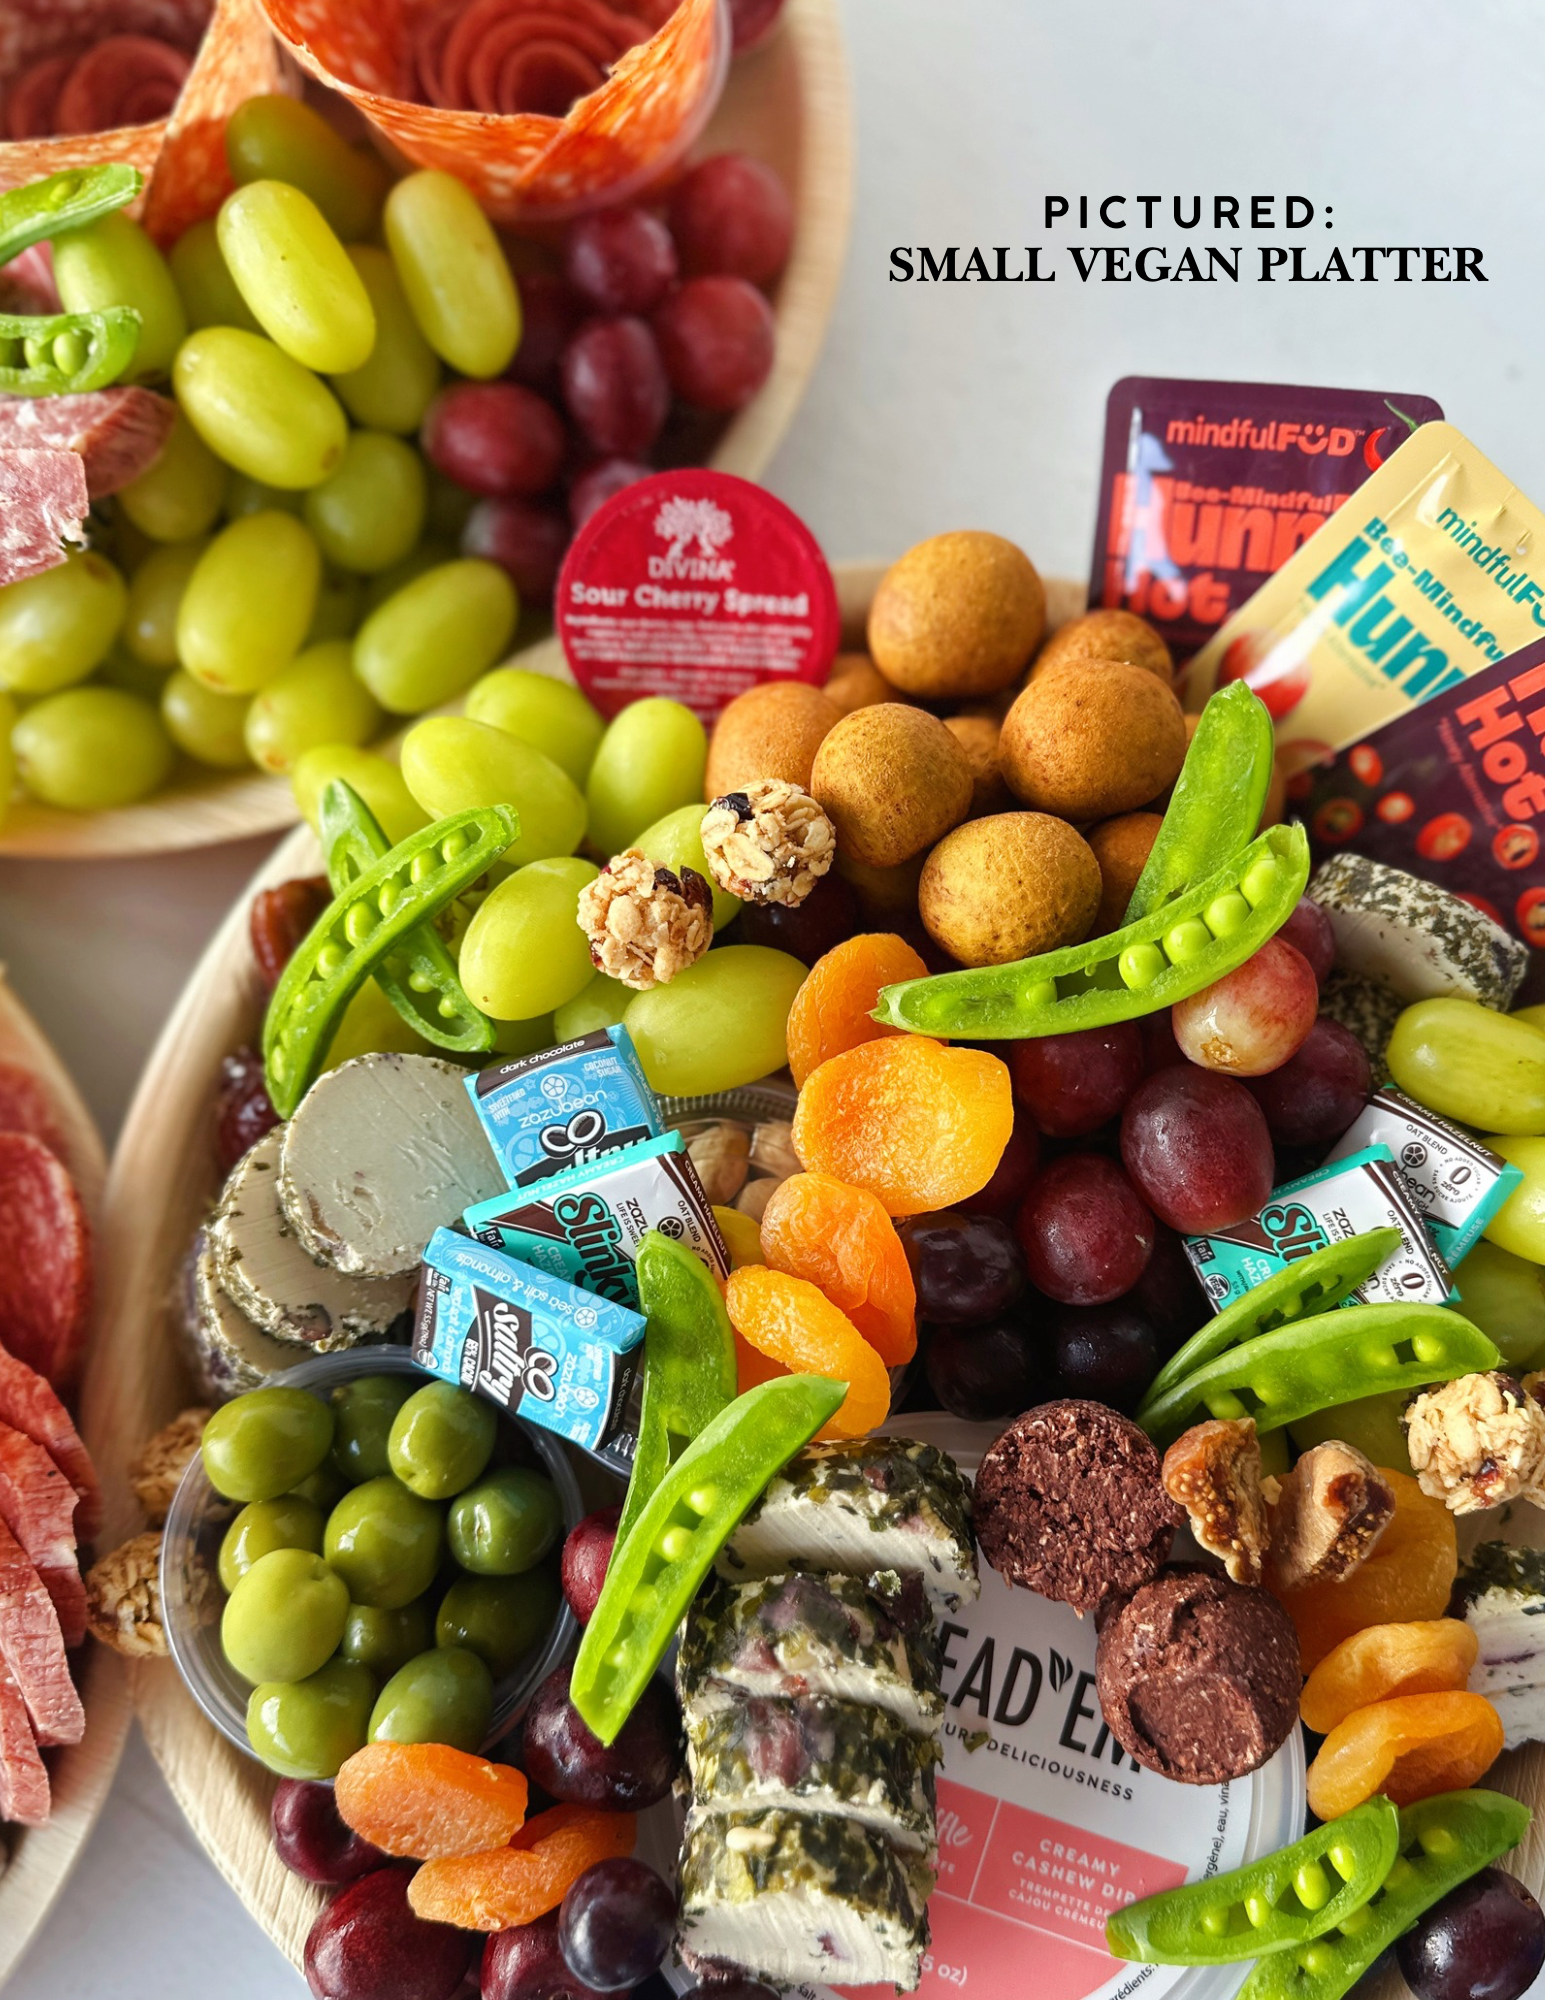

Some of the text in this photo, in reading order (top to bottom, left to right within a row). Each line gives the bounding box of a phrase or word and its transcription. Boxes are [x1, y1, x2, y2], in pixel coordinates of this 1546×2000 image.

[648, 556, 735, 581] DIVINA
[570, 582, 810, 617] Sour Cherry Spread
[1363, 516, 1506, 662] Bee-Mindfu
[499, 1039, 585, 1074] dark chocolate
[518, 1089, 608, 1128] zazubean
[1396, 1092, 1493, 1157] CREAMY HAZELNUT
[1406, 1124, 1448, 1155] OAT BLEND
[578, 1156, 624, 1177] CREAMY
[616, 1202, 628, 1219] LIFE
[685, 1160, 728, 1256] CREAMY HAZELNUT
[1392, 1170, 1420, 1216] CREAMY
[677, 1200, 701, 1243] OAT BLEND
[1322, 1213, 1335, 1231] LIFE
[457, 1253, 511, 1283] almonds
[547, 1246, 572, 1281] CREAM
[512, 1278, 524, 1292] &
[524, 1285, 549, 1302] salt
[1209, 1275, 1225, 1297] VEGAN
[548, 1296, 574, 1314] sea
[987, 1737, 1134, 1801] DELICIOUSNESS
[1219, 1781, 1230, 1806] vina
[1039, 1838, 1120, 1877] CREAMY
[1012, 1851, 1137, 1904] CASHEW DIP
[1020, 1878, 1091, 1912] TREMPETTE
[1009, 1888, 1106, 1931] CAJOU CRÉMEU
